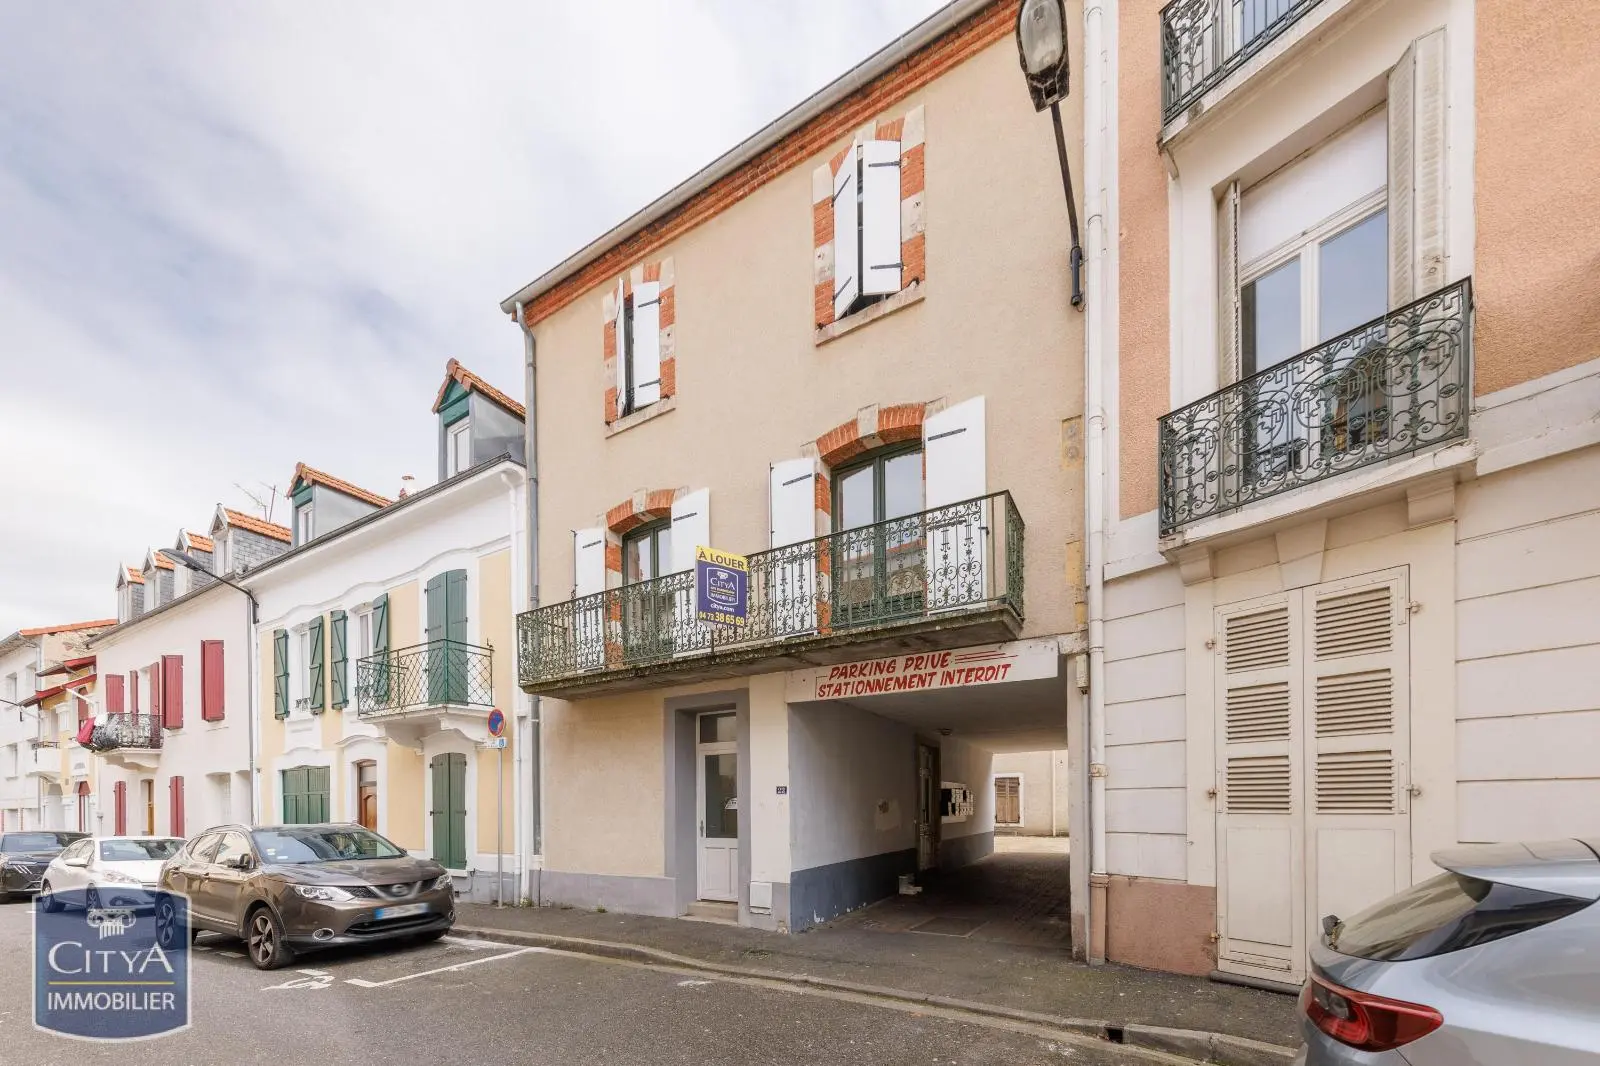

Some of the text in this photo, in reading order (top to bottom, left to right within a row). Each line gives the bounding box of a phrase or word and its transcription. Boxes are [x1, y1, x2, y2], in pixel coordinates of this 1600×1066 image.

[710, 553, 745, 570] LOUER
[715, 611, 725, 623] 38
[725, 613, 735, 625] 65
[828, 659, 897, 681] PARKING
[817, 663, 1012, 698] STATIONNEMENT INTERDIT
